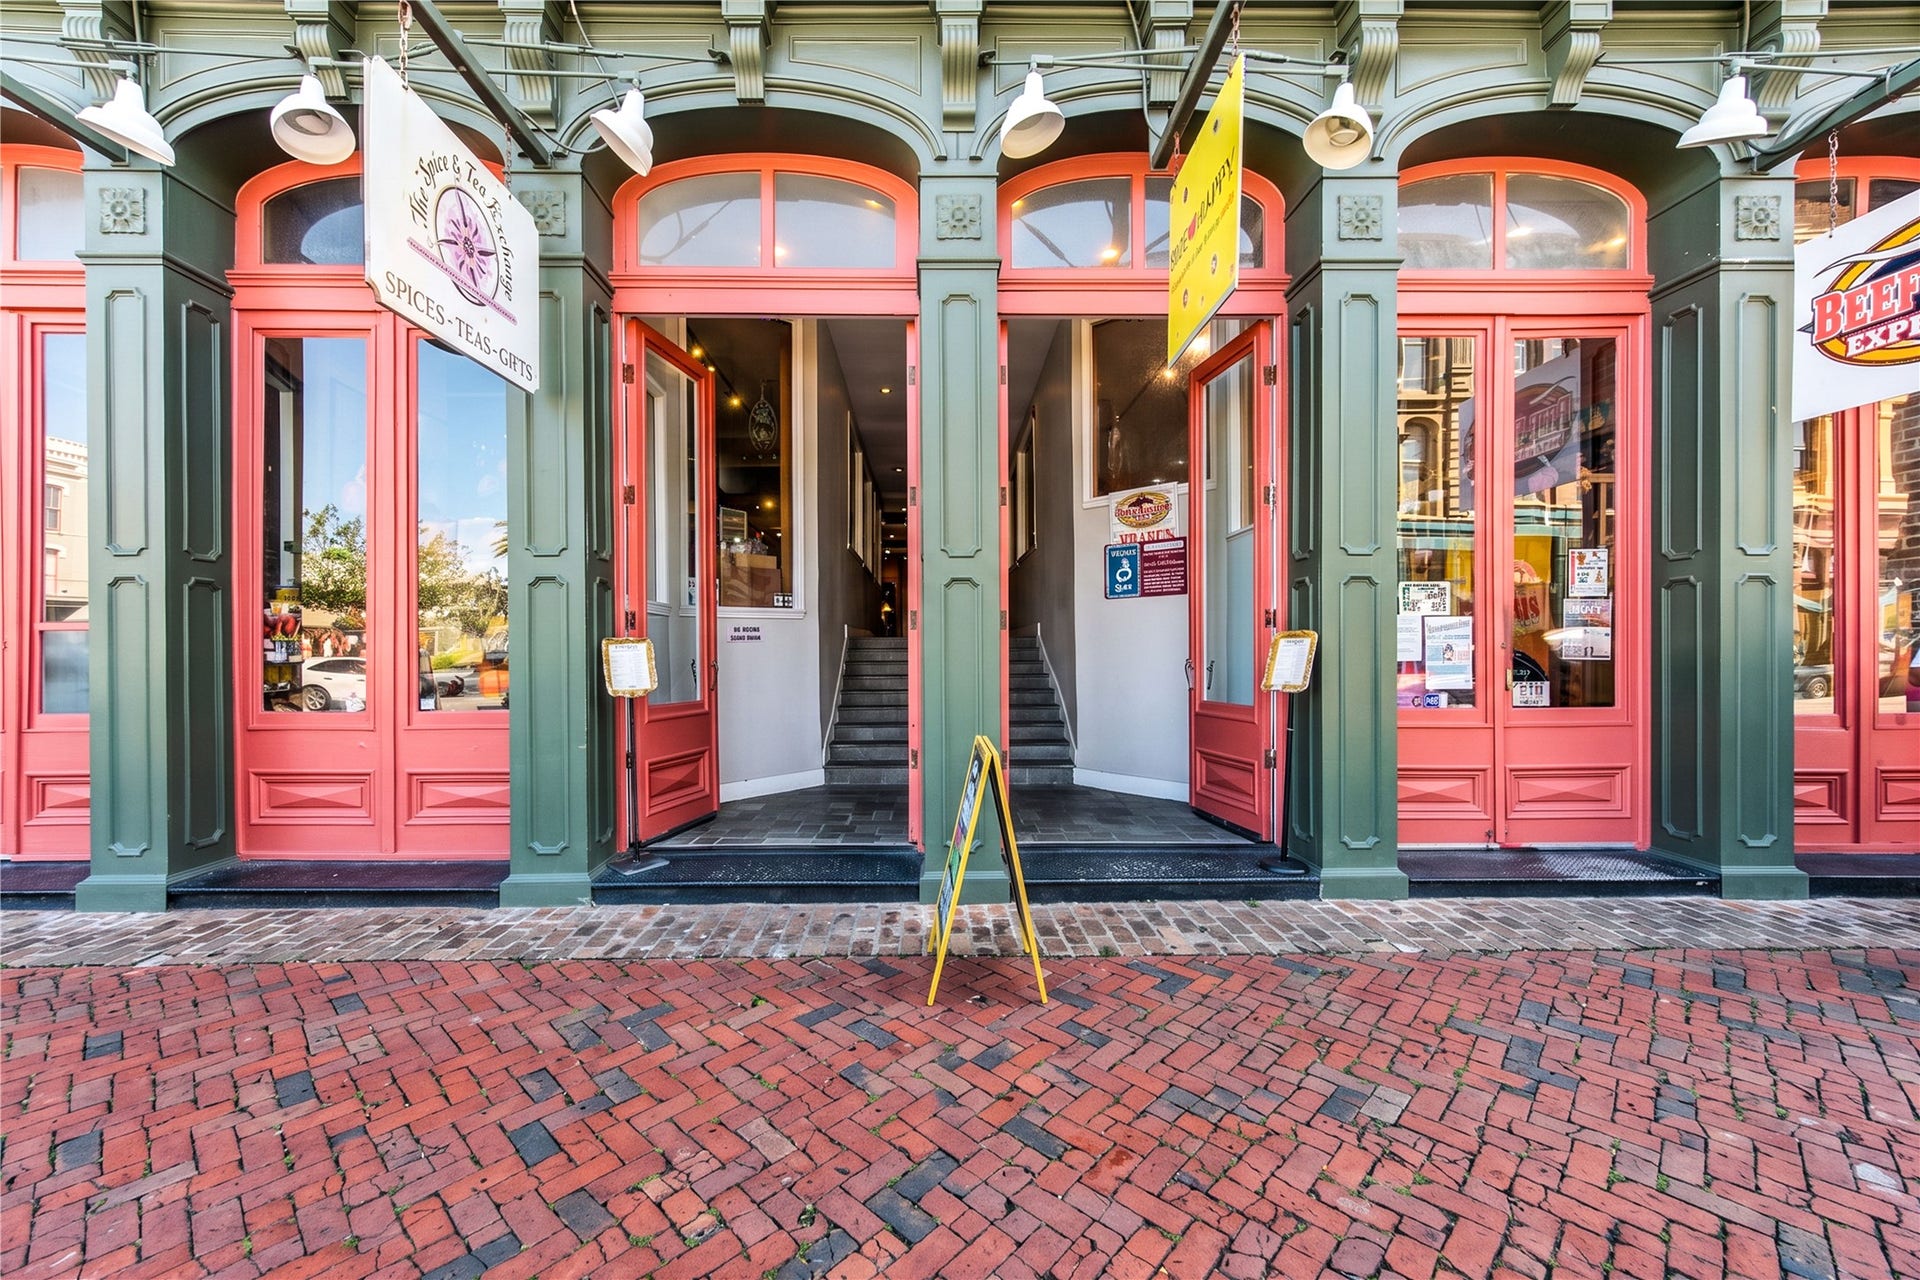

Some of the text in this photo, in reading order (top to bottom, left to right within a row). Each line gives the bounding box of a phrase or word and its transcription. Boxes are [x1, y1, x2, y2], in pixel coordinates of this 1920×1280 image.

[409, 151, 514, 302] The Spice & Tea Exchange
[386, 271, 445, 325] SPICES
[456, 317, 491, 355] TEAS
[499, 348, 533, 382] GIFTS
[1815, 265, 1920, 342] BEEF
